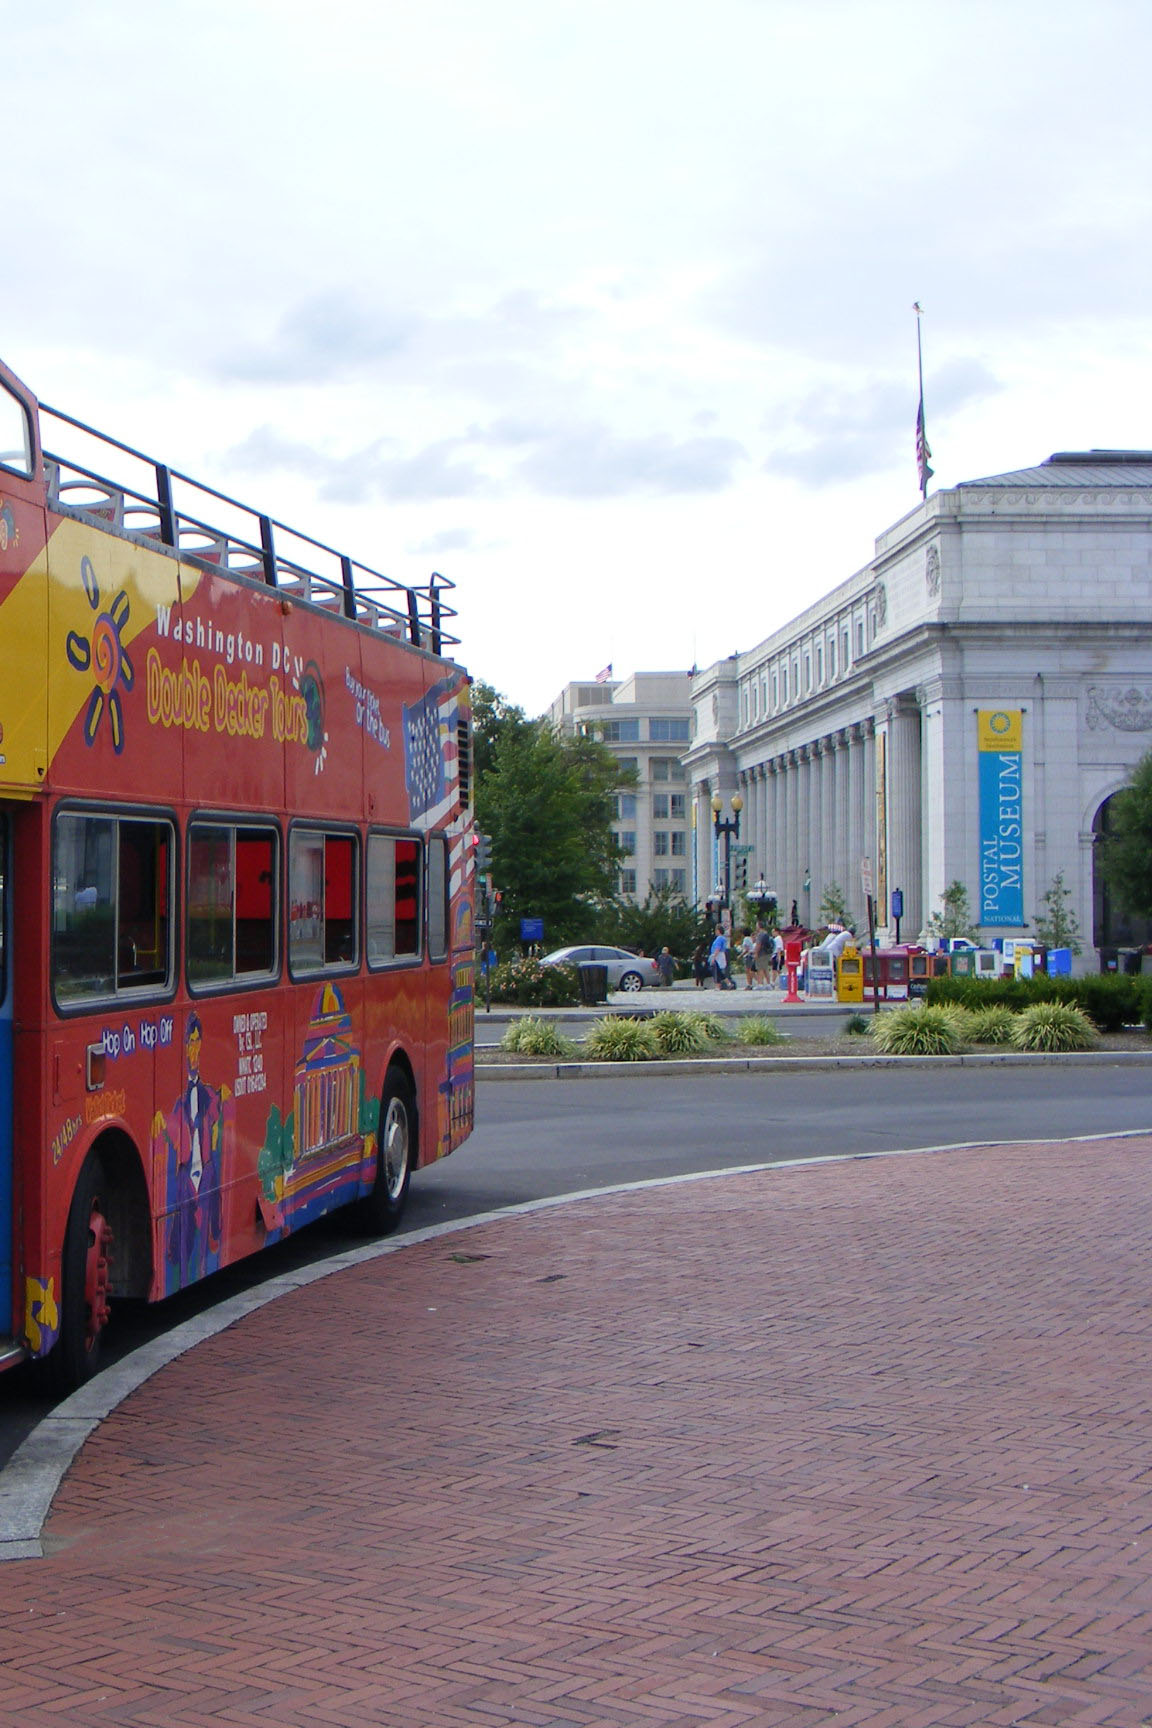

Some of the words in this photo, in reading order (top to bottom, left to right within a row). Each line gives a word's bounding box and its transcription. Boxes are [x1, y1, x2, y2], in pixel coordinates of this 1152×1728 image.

[157, 604, 263, 664] Washington
[272, 642, 290, 674] DC
[147, 647, 211, 732] Double
[214, 664, 268, 739] Decker
[270, 675, 308, 744] Tours
[1000, 753, 1020, 889] MUSEUM
[983, 834, 999, 911] POSTAL
[984, 915, 1021, 923] NATIONAL
[102, 1030, 121, 1057] Hop
[123, 1025, 136, 1052] On
[141, 1022, 158, 1048] Hop
[160, 1018, 174, 1043] Off
